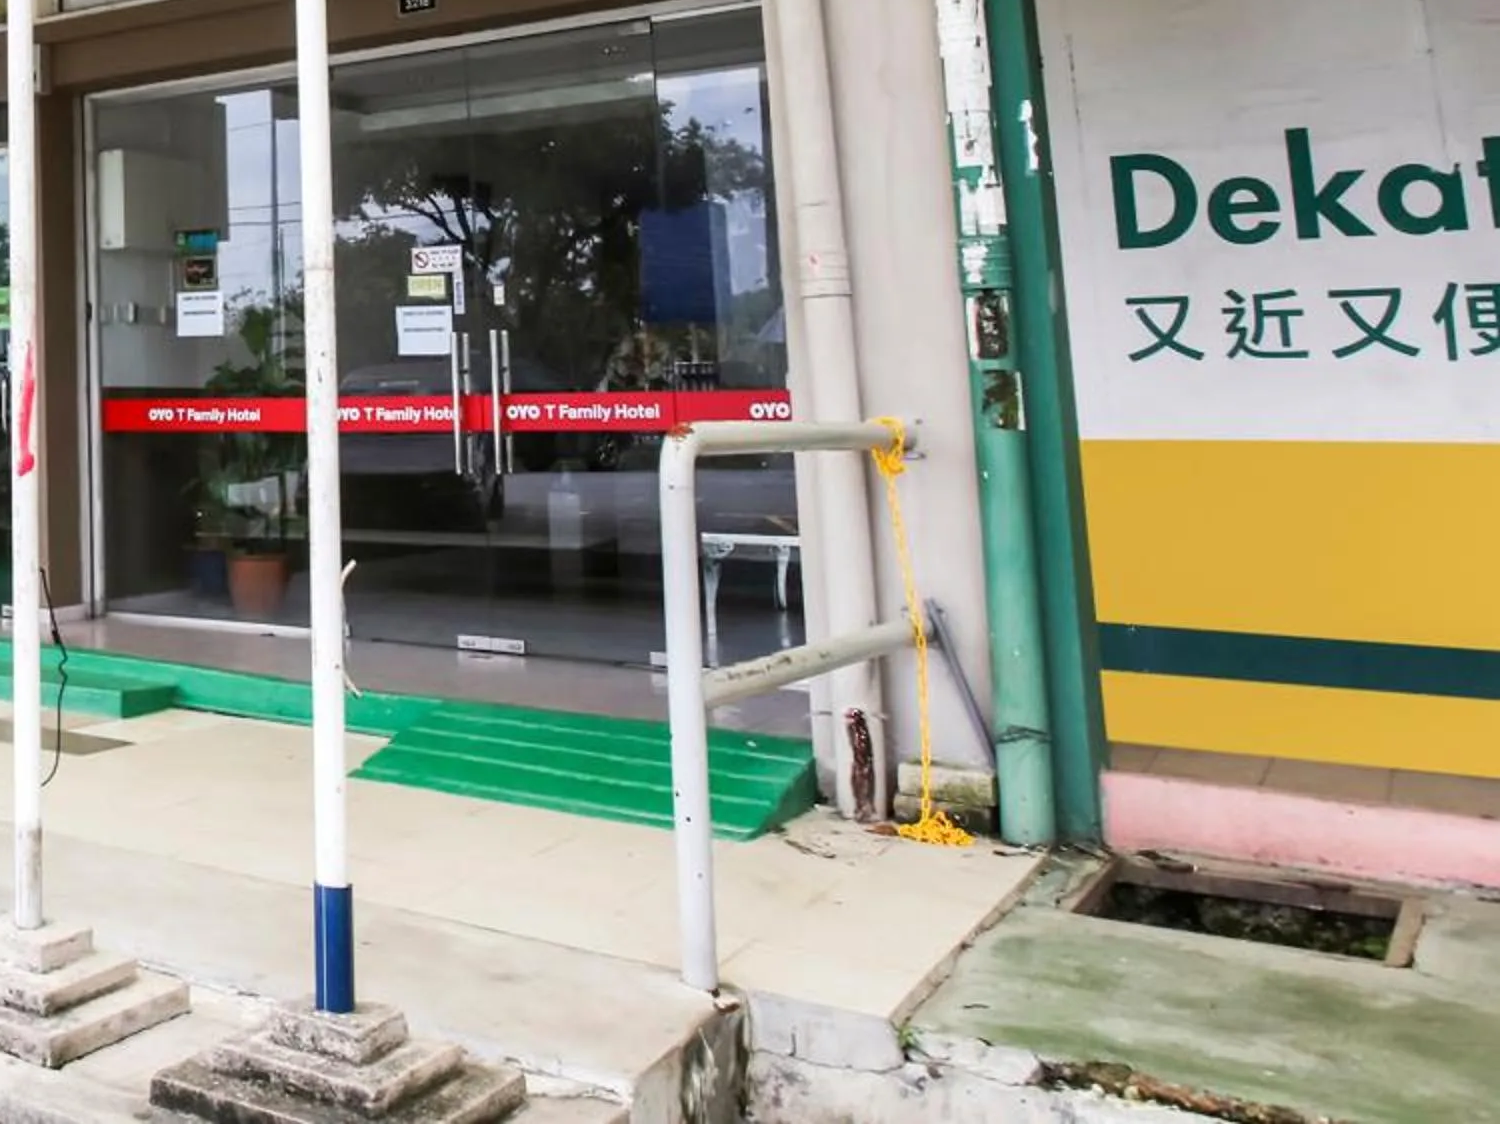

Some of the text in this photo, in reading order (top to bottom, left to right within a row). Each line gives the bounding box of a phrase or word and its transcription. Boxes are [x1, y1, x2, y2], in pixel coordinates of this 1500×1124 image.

[148, 407, 260, 425] OYO T Family Hotel
[363, 407, 374, 421] T
[376, 406, 421, 425] Family
[423, 406, 458, 421] Hot
[507, 404, 661, 423] OYO T Family Hotel
[749, 402, 790, 419] OYO
